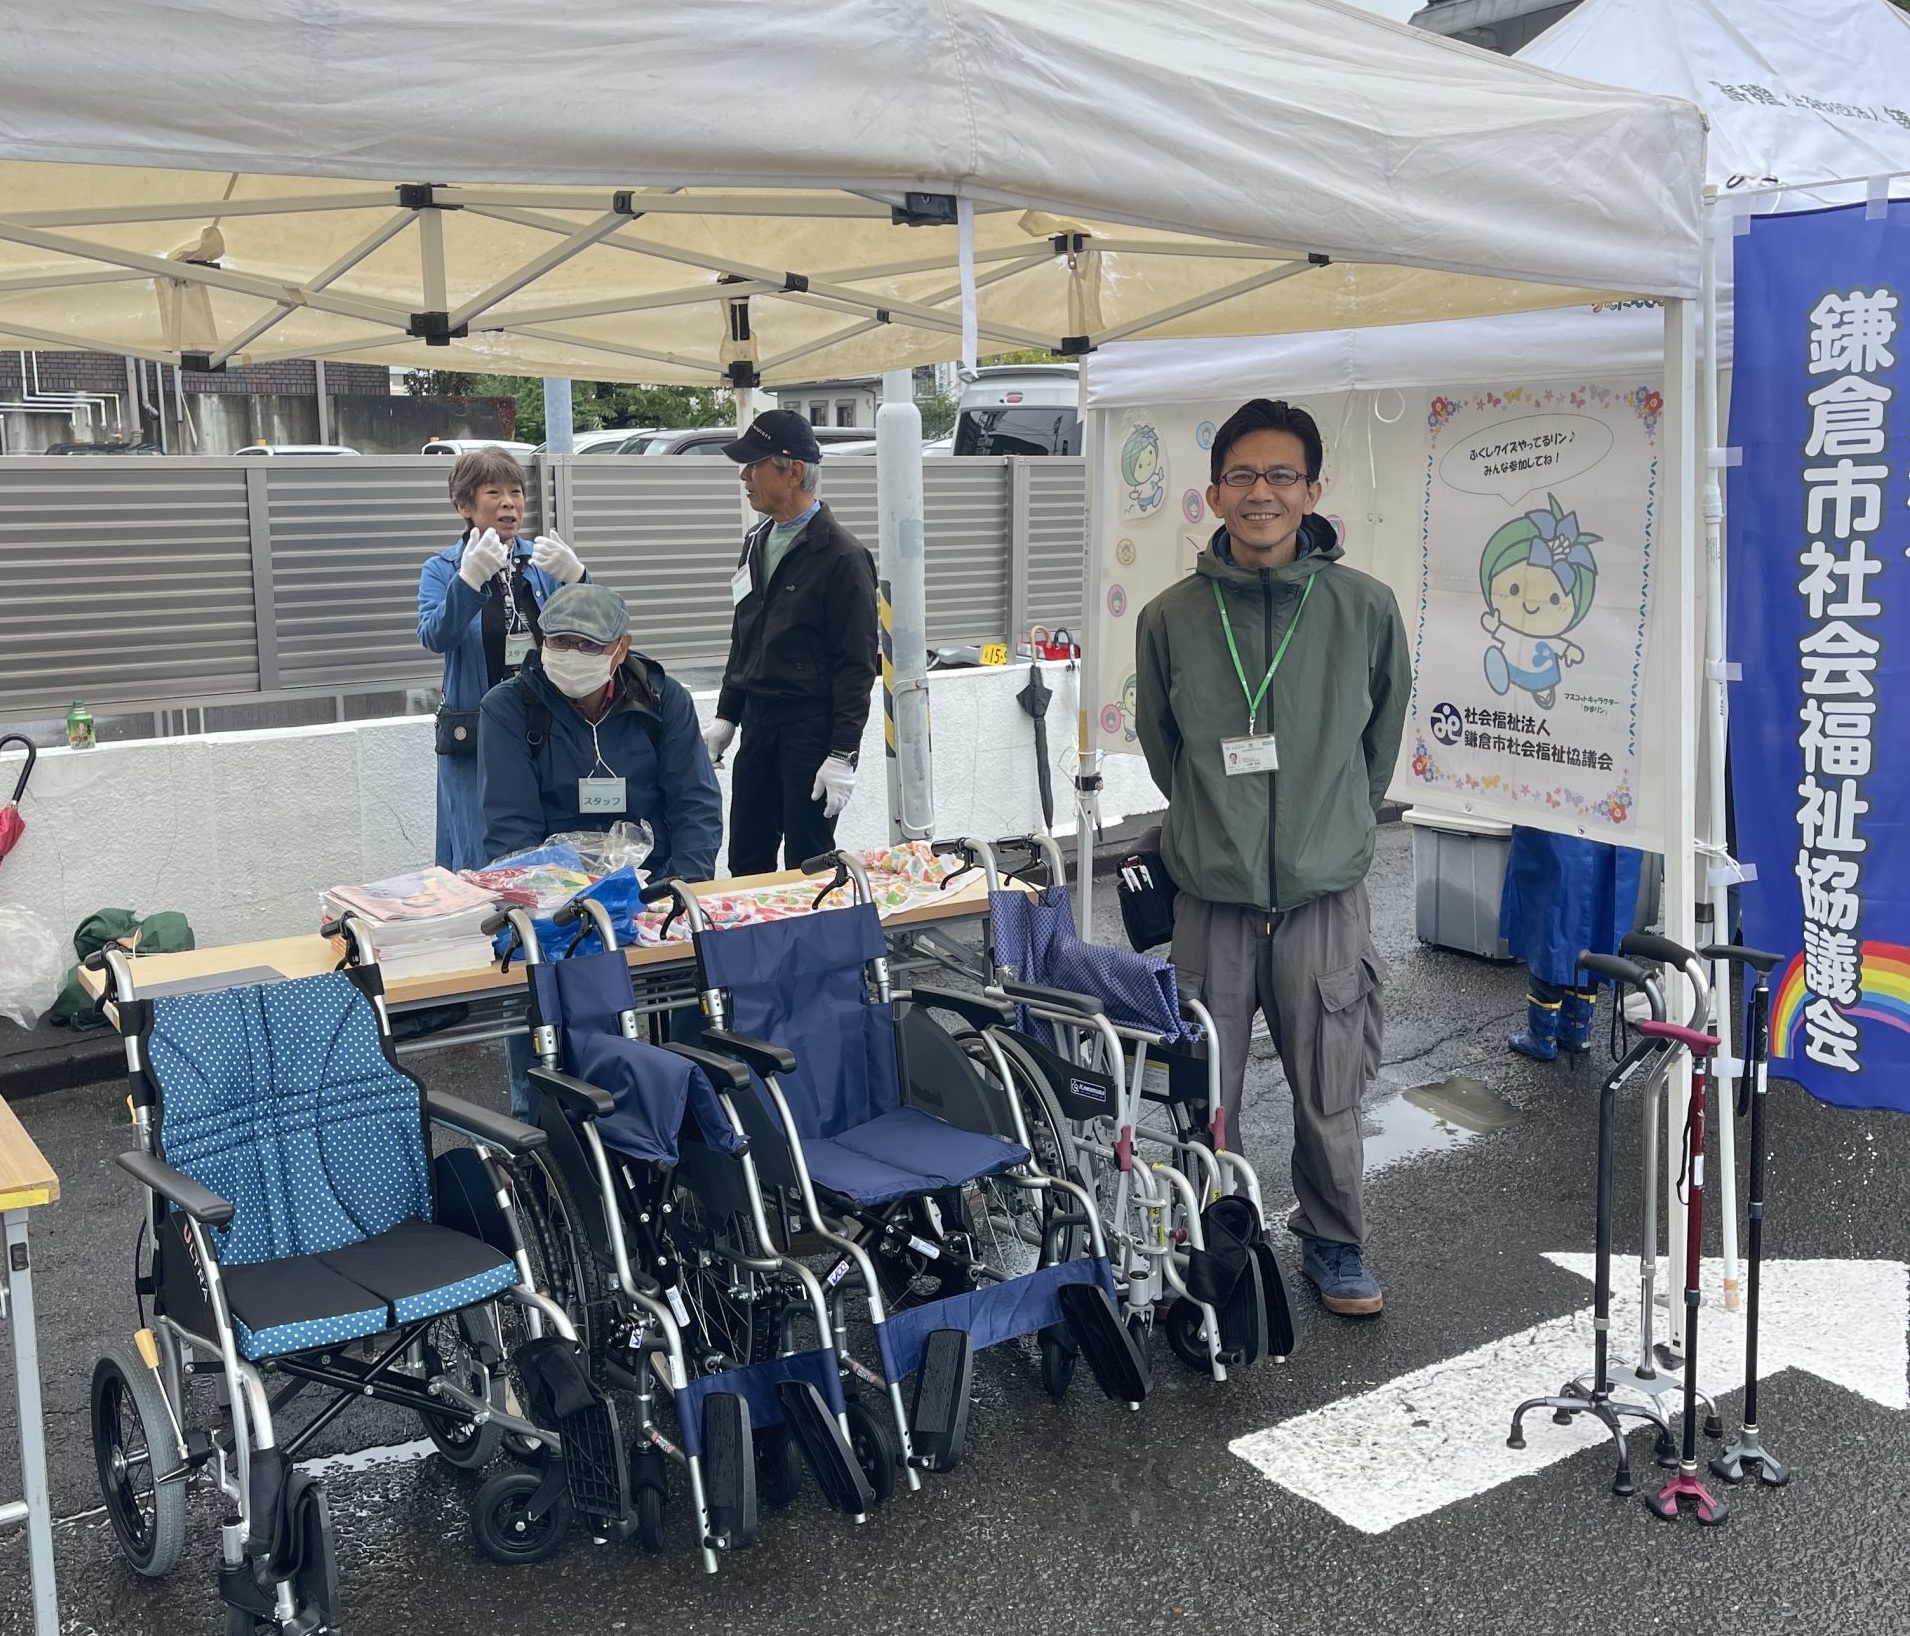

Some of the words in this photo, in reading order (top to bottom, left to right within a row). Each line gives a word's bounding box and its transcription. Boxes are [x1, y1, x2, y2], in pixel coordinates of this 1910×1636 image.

[1796, 289, 1898, 1072] 鎌倉市社会福祉協議会
[1564, 693, 1619, 706] マスコットキャラクター
[1464, 706, 1551, 737] 社会福祉法人
[1464, 729, 1614, 772] 鎌倉市社会福祉協議会
[584, 797, 621, 806] スタッフ
